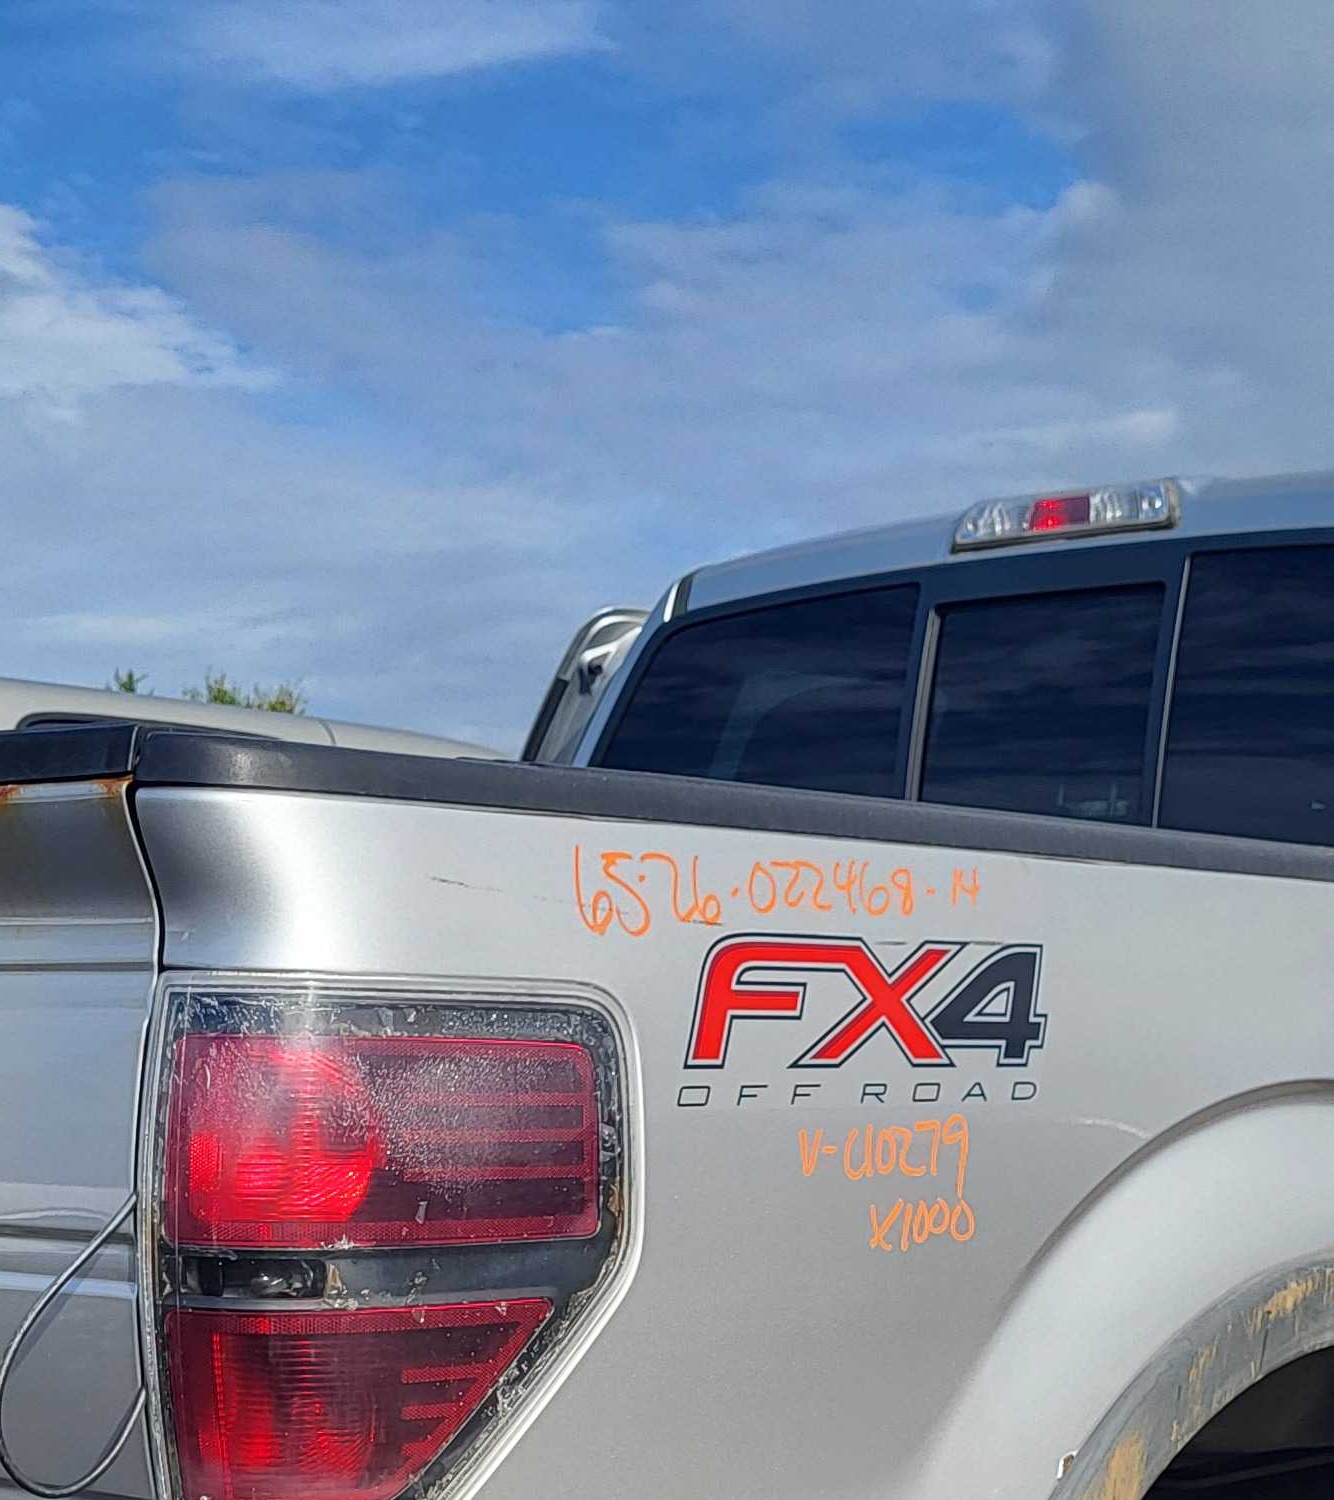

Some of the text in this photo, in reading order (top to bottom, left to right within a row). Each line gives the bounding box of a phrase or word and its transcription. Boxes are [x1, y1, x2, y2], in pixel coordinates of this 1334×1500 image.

[683, 933, 1049, 1071] FX4
[677, 1080, 1038, 1108] OFF ROAD
